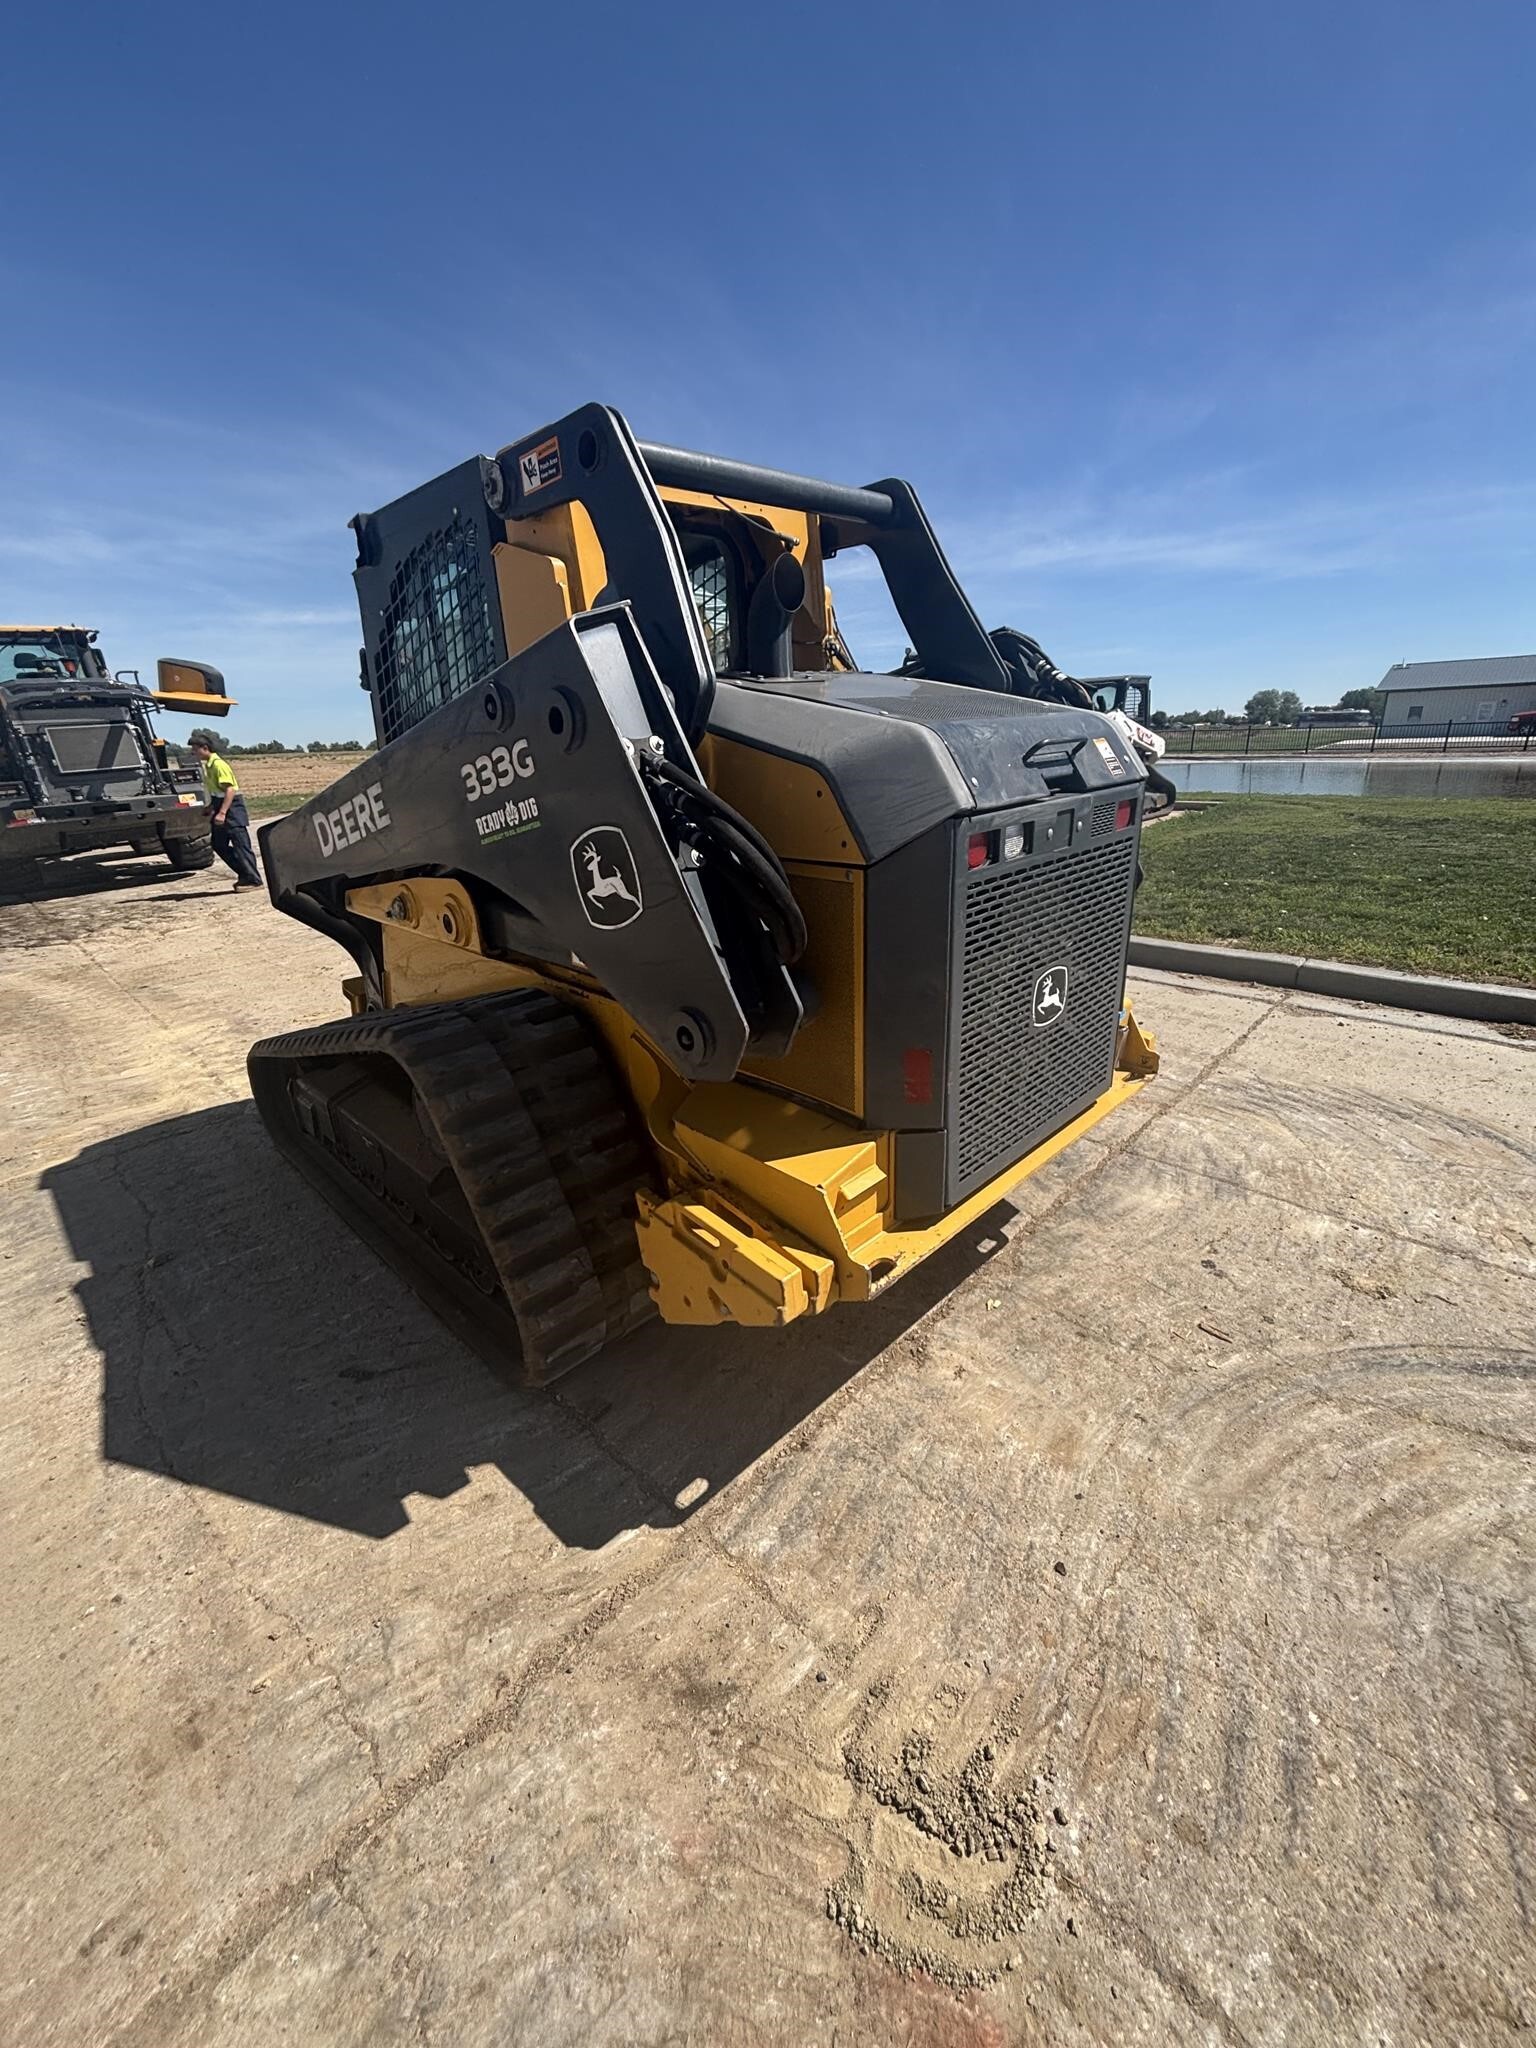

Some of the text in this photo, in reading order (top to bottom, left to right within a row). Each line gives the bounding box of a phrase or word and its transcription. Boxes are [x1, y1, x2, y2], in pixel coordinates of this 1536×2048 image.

[461, 738, 535, 802] 333G
[312, 782, 392, 858] DEERE
[475, 809, 506, 836] READY
[518, 797, 539, 821] DIG
